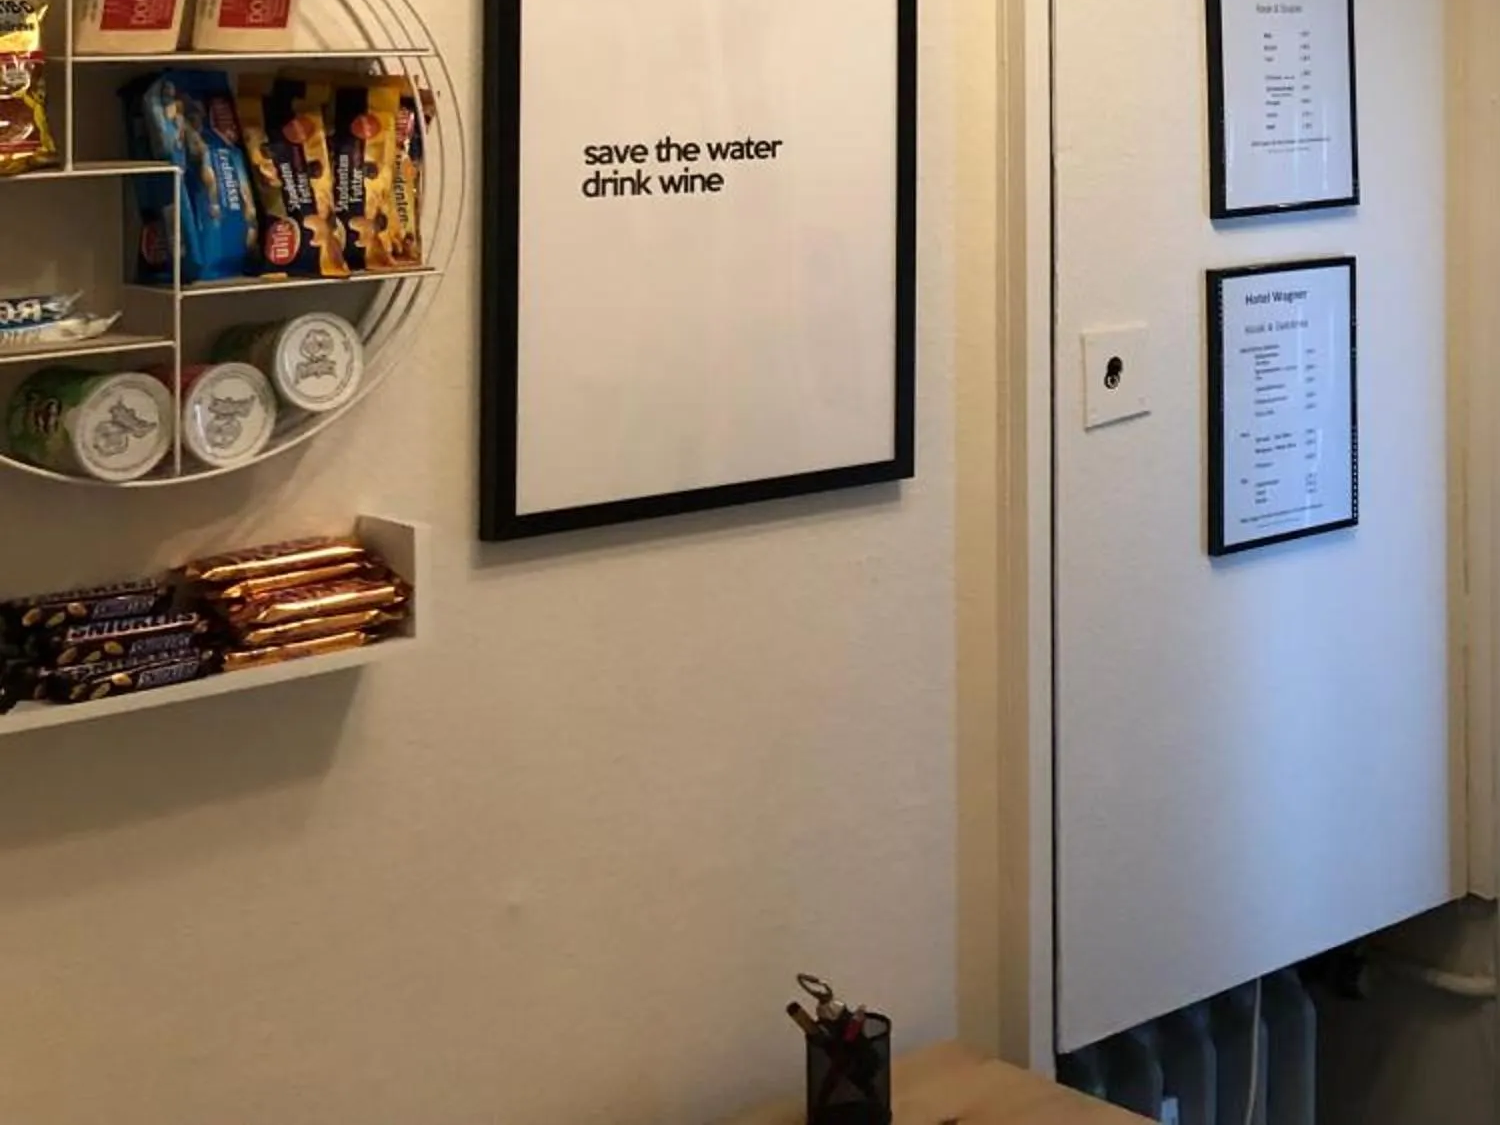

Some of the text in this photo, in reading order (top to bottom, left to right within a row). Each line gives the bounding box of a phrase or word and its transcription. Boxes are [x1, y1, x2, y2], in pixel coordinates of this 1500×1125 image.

[583, 135, 784, 166] save the water
[581, 166, 725, 198] drink wine
[1245, 289, 1308, 306] Hotel Wagner
